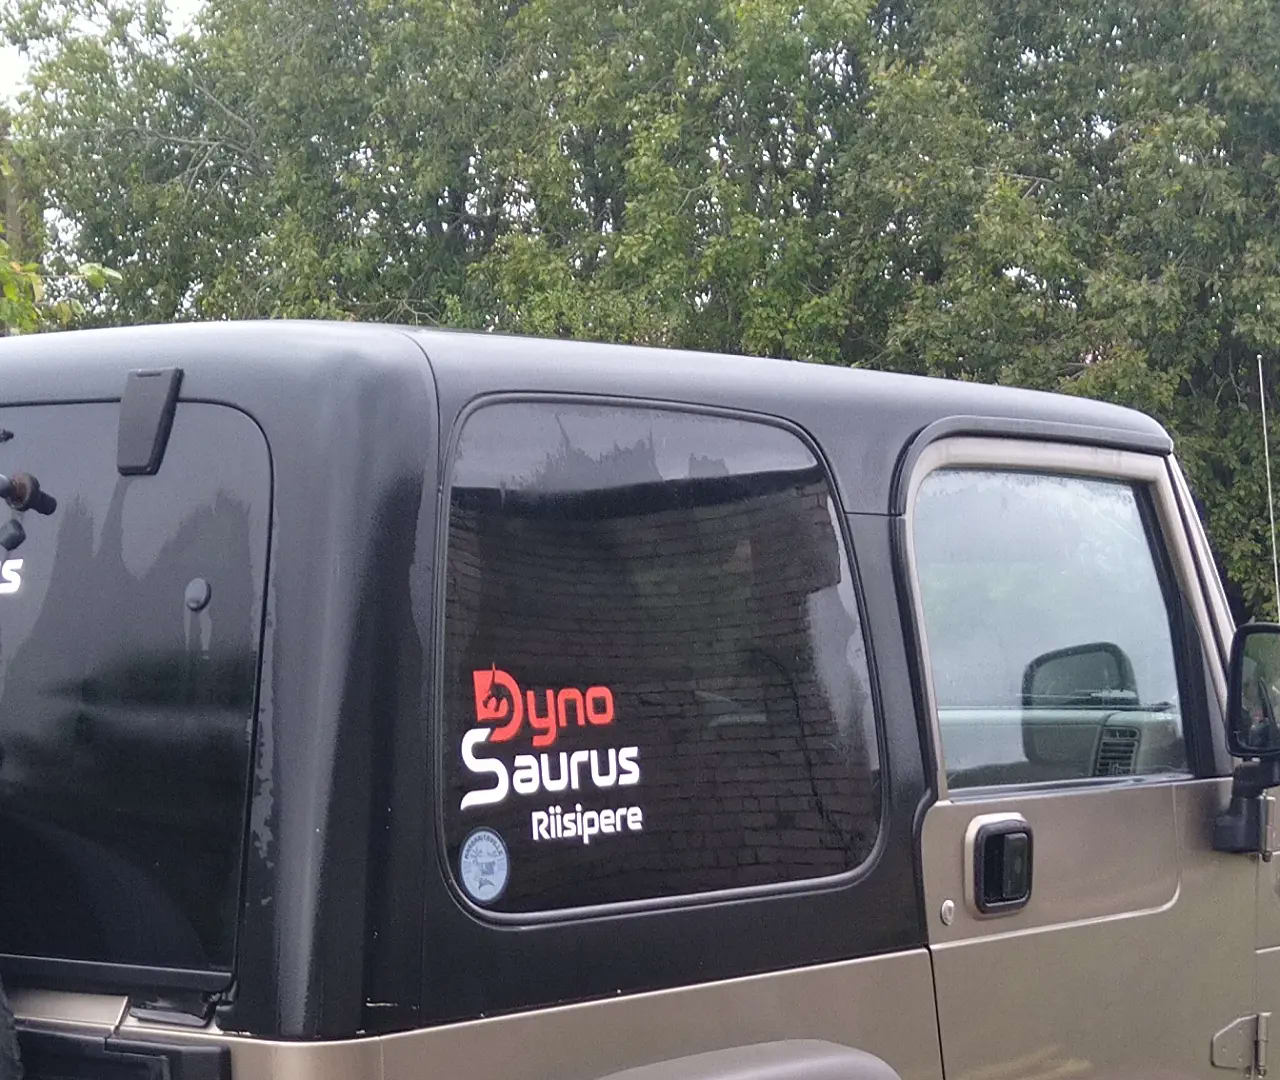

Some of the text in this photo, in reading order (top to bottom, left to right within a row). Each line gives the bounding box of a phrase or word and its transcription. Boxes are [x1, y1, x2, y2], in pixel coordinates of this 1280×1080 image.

[473, 664, 615, 746] Dyno
[460, 727, 640, 811] Saurus
[531, 803, 643, 844] Riisipere
